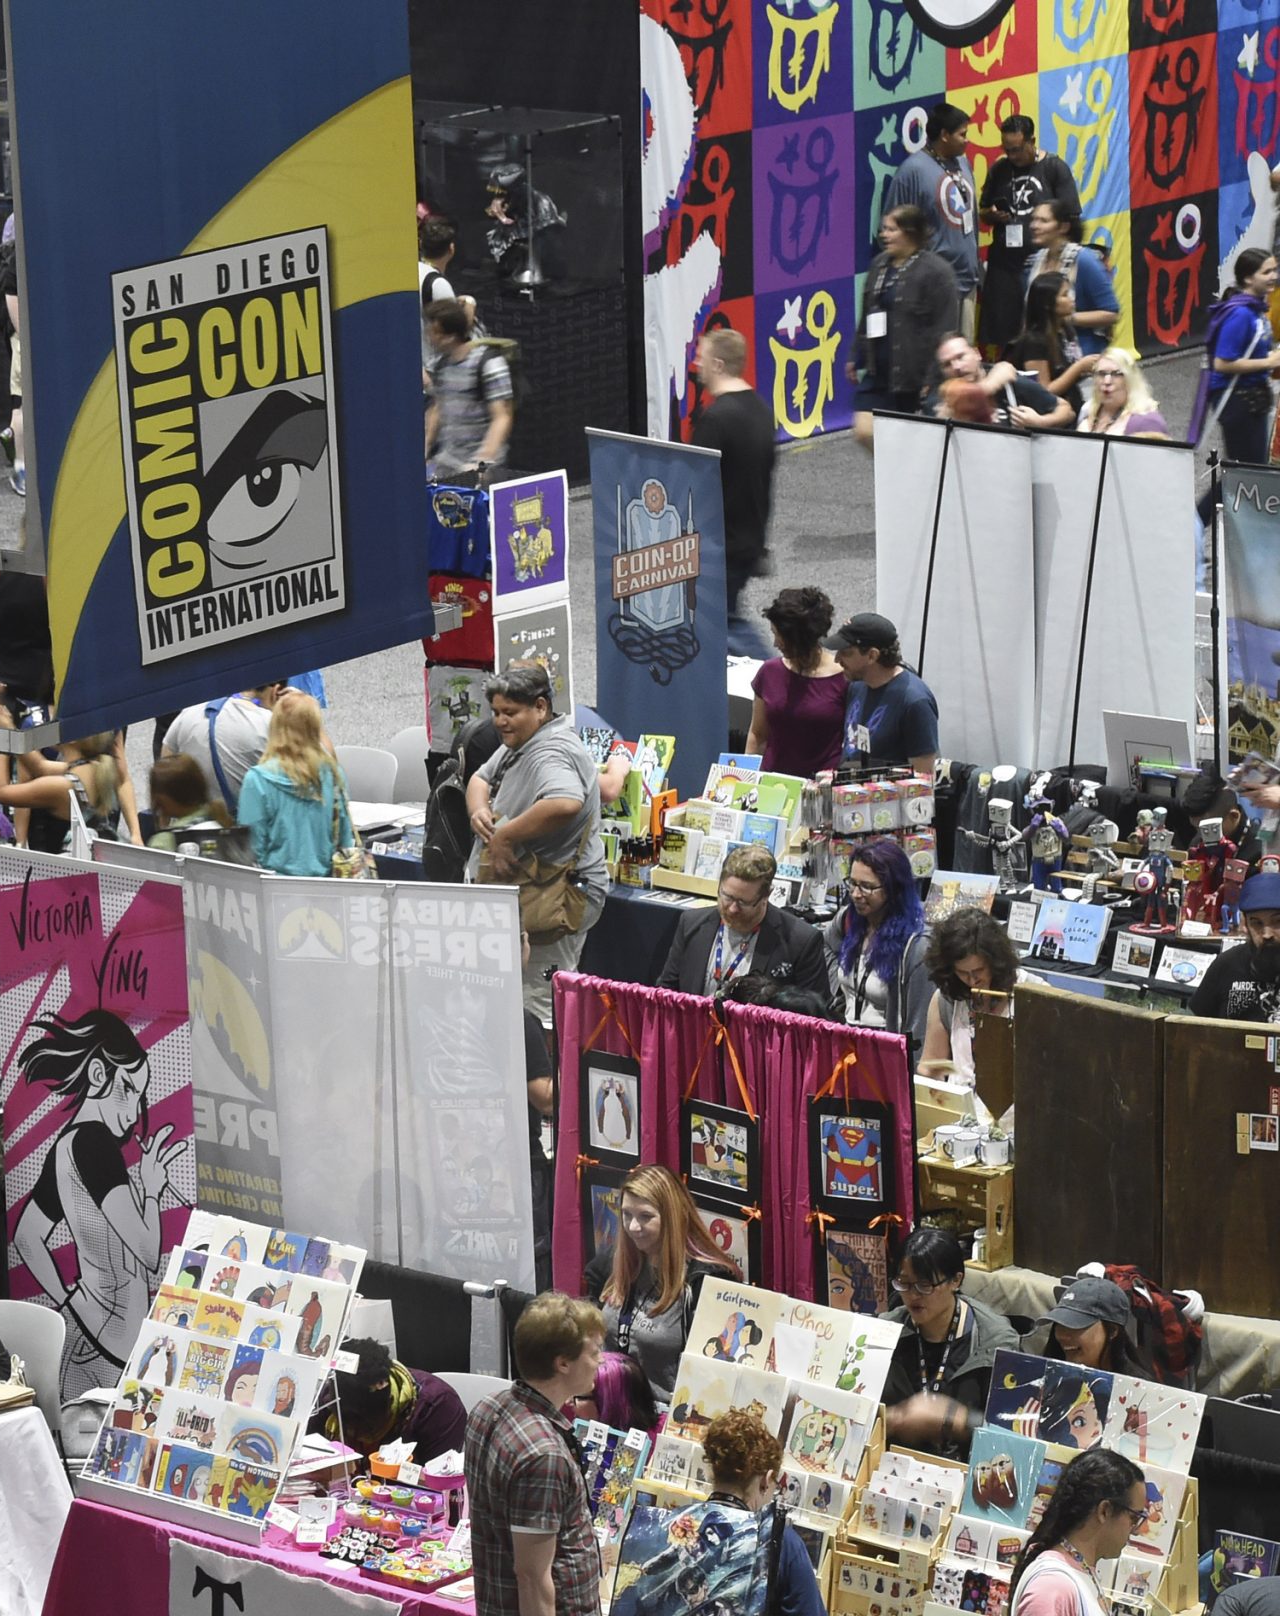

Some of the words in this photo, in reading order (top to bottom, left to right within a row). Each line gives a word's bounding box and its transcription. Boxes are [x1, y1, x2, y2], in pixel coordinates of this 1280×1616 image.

[121, 272, 184, 318] SAN
[217, 243, 320, 295] DIEGO
[198, 286, 323, 400] CON
[129, 317, 206, 599] COMIC
[616, 537, 697, 579] COIN-OP
[616, 561, 697, 595] CARNIVAL
[146, 564, 339, 651] INTERNATIONAL
[10, 866, 93, 951] VICTORIA
[91, 930, 148, 1010] YING
[1232, 981, 1256, 991] MURDE
[830, 1181, 878, 1196] super.
[247, 1467, 279, 1480] NOTHING
